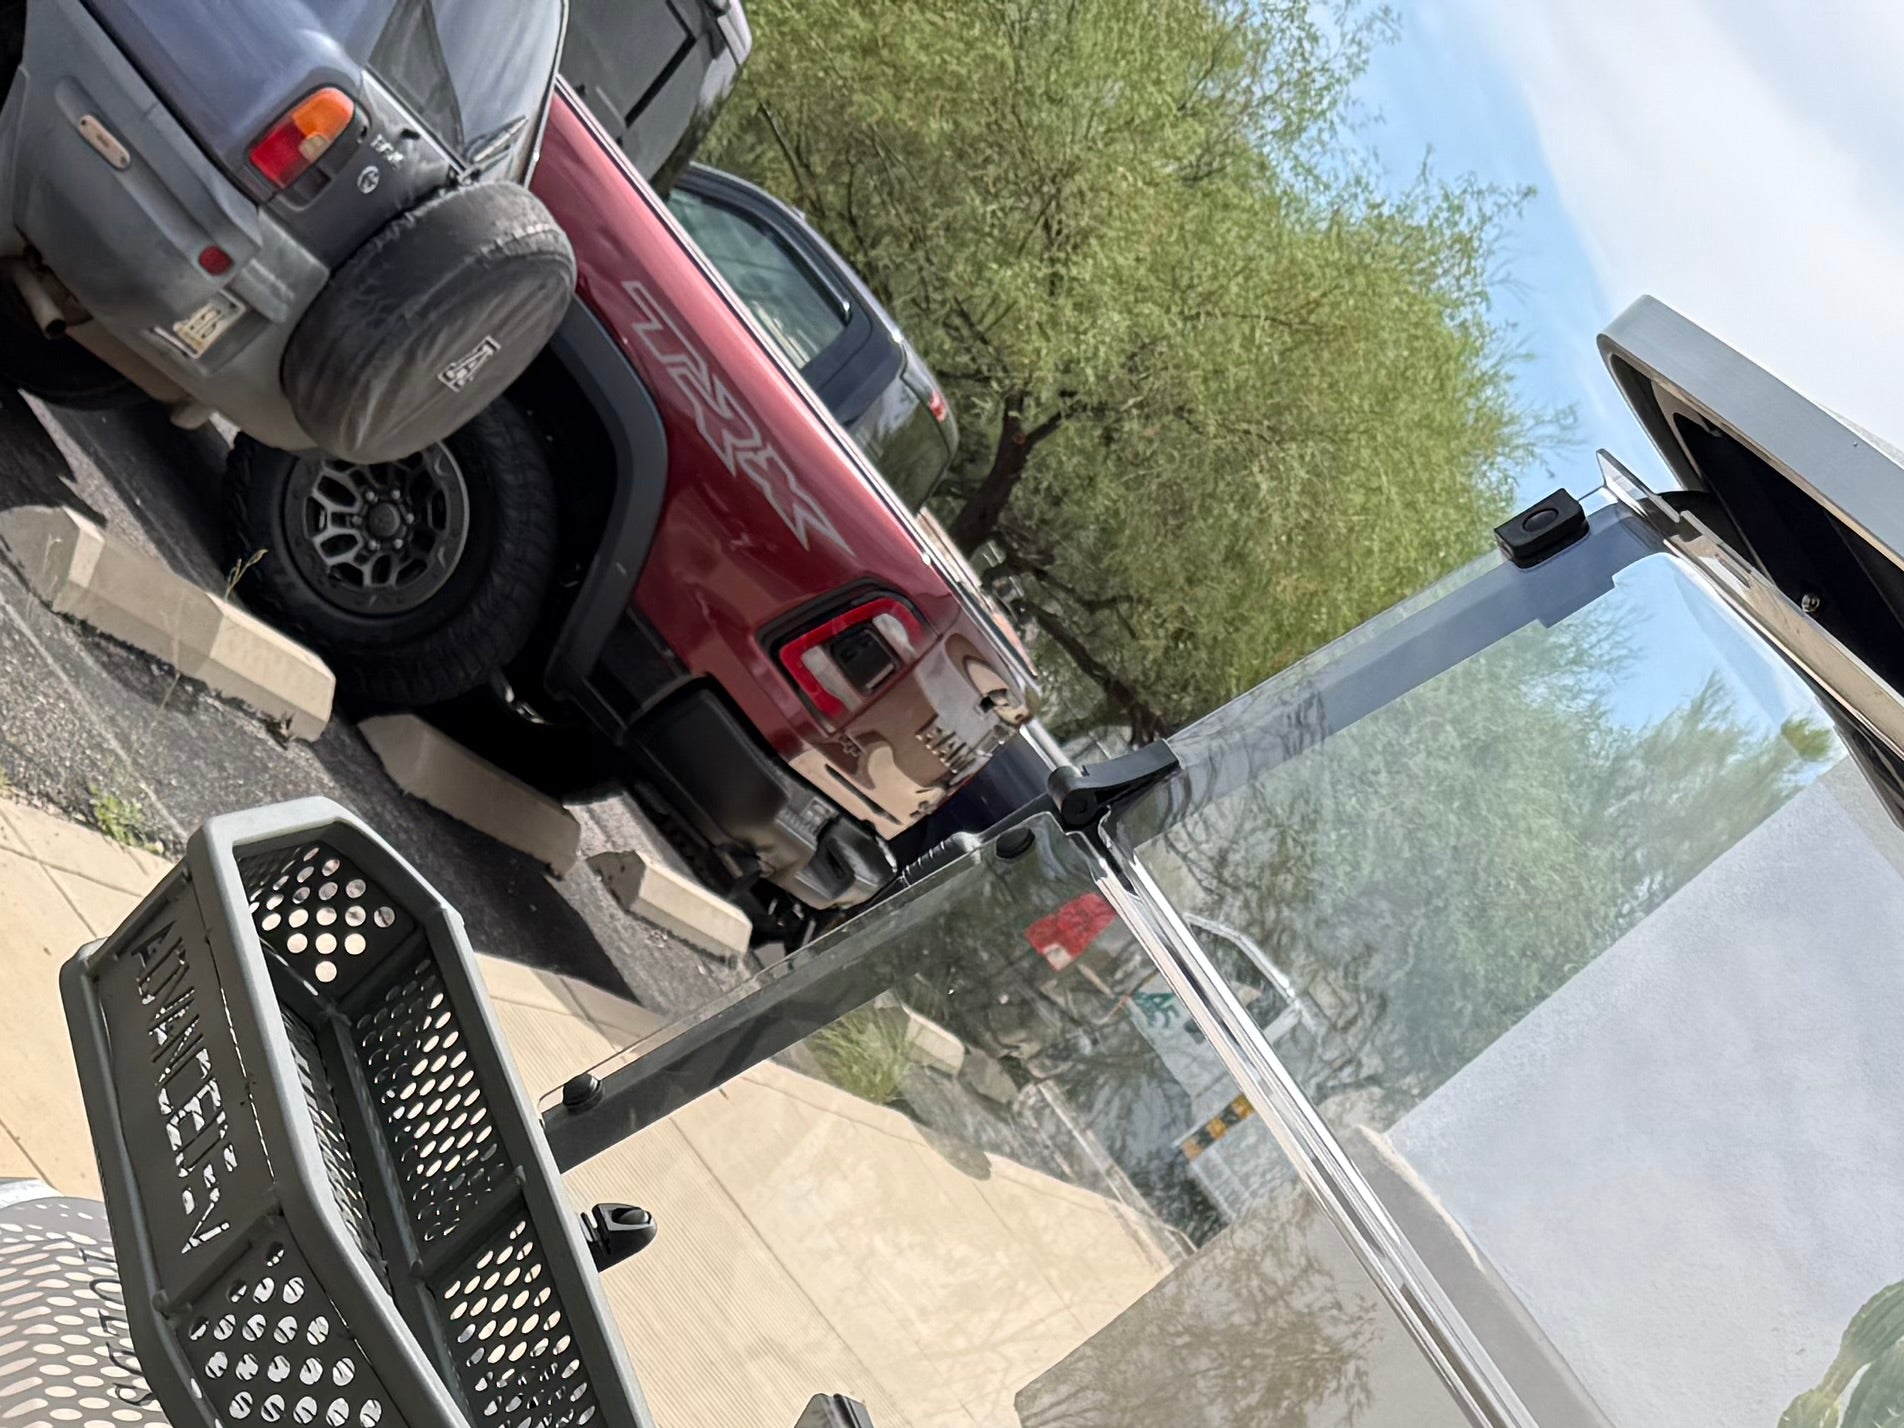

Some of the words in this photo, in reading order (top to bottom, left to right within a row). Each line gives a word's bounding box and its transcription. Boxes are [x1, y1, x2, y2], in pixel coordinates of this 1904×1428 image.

[622, 281, 857, 558] TRX
[131, 920, 229, 1178] ADVANCED
[180, 1144, 238, 1256] EV
